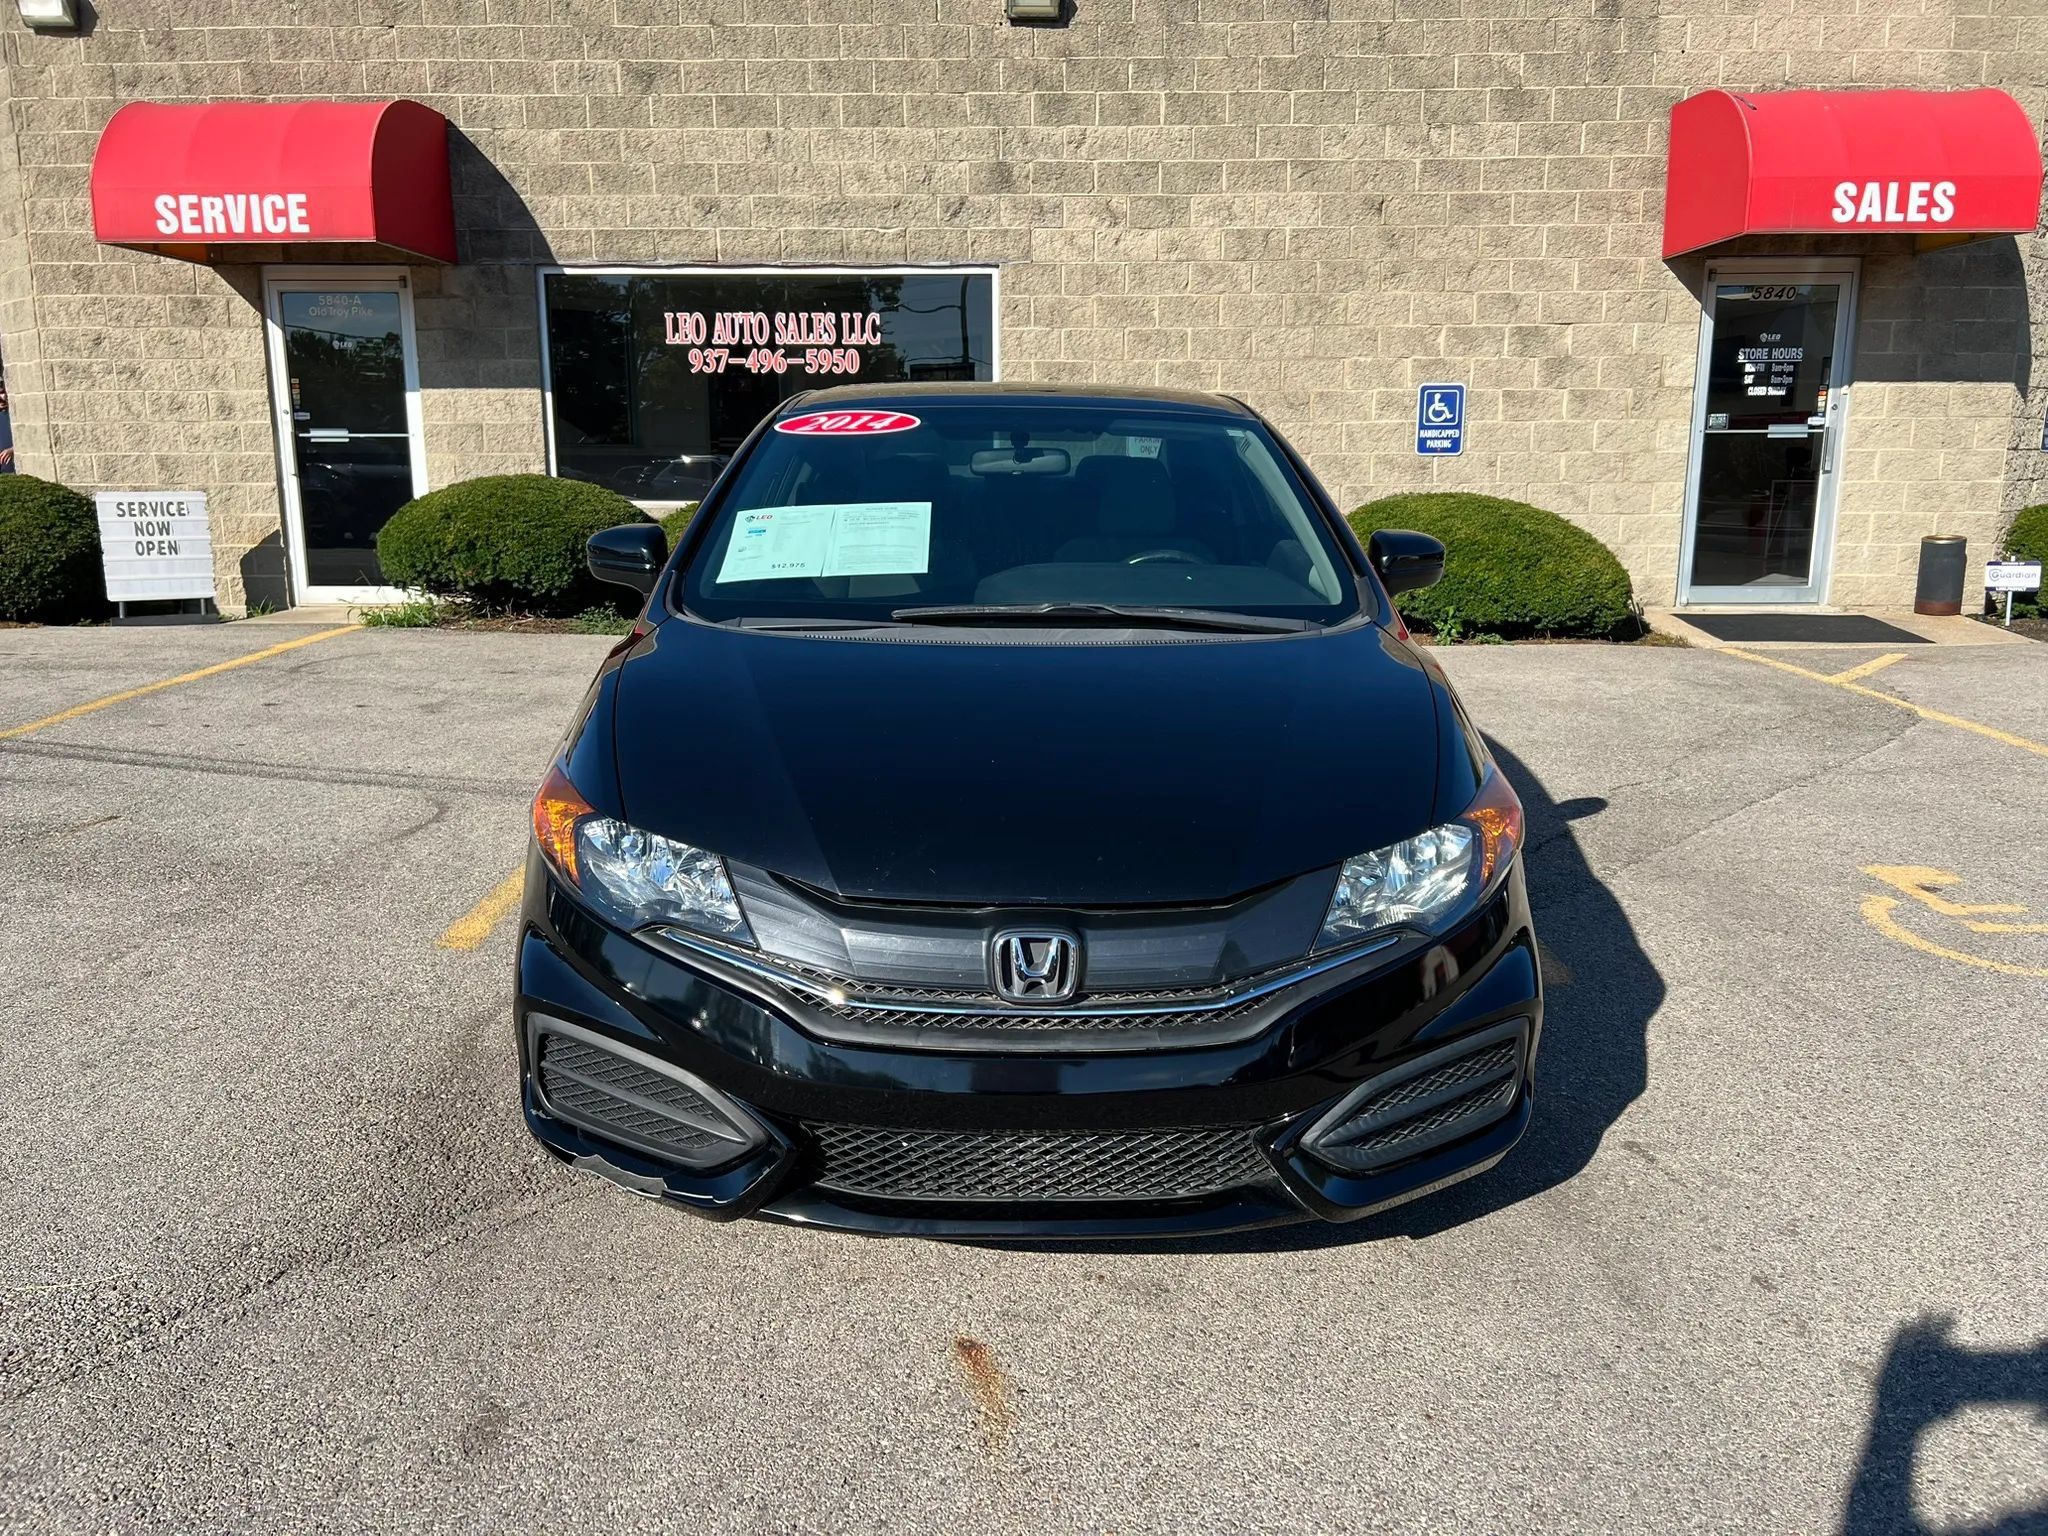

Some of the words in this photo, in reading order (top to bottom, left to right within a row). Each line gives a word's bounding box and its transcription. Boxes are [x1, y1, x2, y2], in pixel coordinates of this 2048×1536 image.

[1831, 181, 1957, 223] SALES
[154, 193, 311, 235] SERVICE
[318, 295, 362, 306] 5840-A
[1751, 286, 1797, 300] 5840
[308, 306, 327, 317] Old
[328, 306, 349, 318] Troy
[351, 306, 374, 317] Pike
[664, 311, 707, 345] LEO
[711, 311, 770, 345] AUTO
[774, 311, 837, 345] SALES
[840, 311, 882, 345] LLC
[688, 348, 861, 374] 937-496-5950
[1738, 348, 1769, 360] STORE
[1771, 347, 1804, 359] HOURS
[1747, 386, 1767, 396] CLOSED
[796, 415, 901, 432] 2014
[1419, 429, 1460, 438] HANDICAPPED
[1426, 439, 1452, 448] PARKING
[115, 501, 187, 518] SERVICE
[133, 520, 171, 537] NOW
[134, 540, 179, 556] OPEN
[1989, 570, 2037, 580] Guardian
